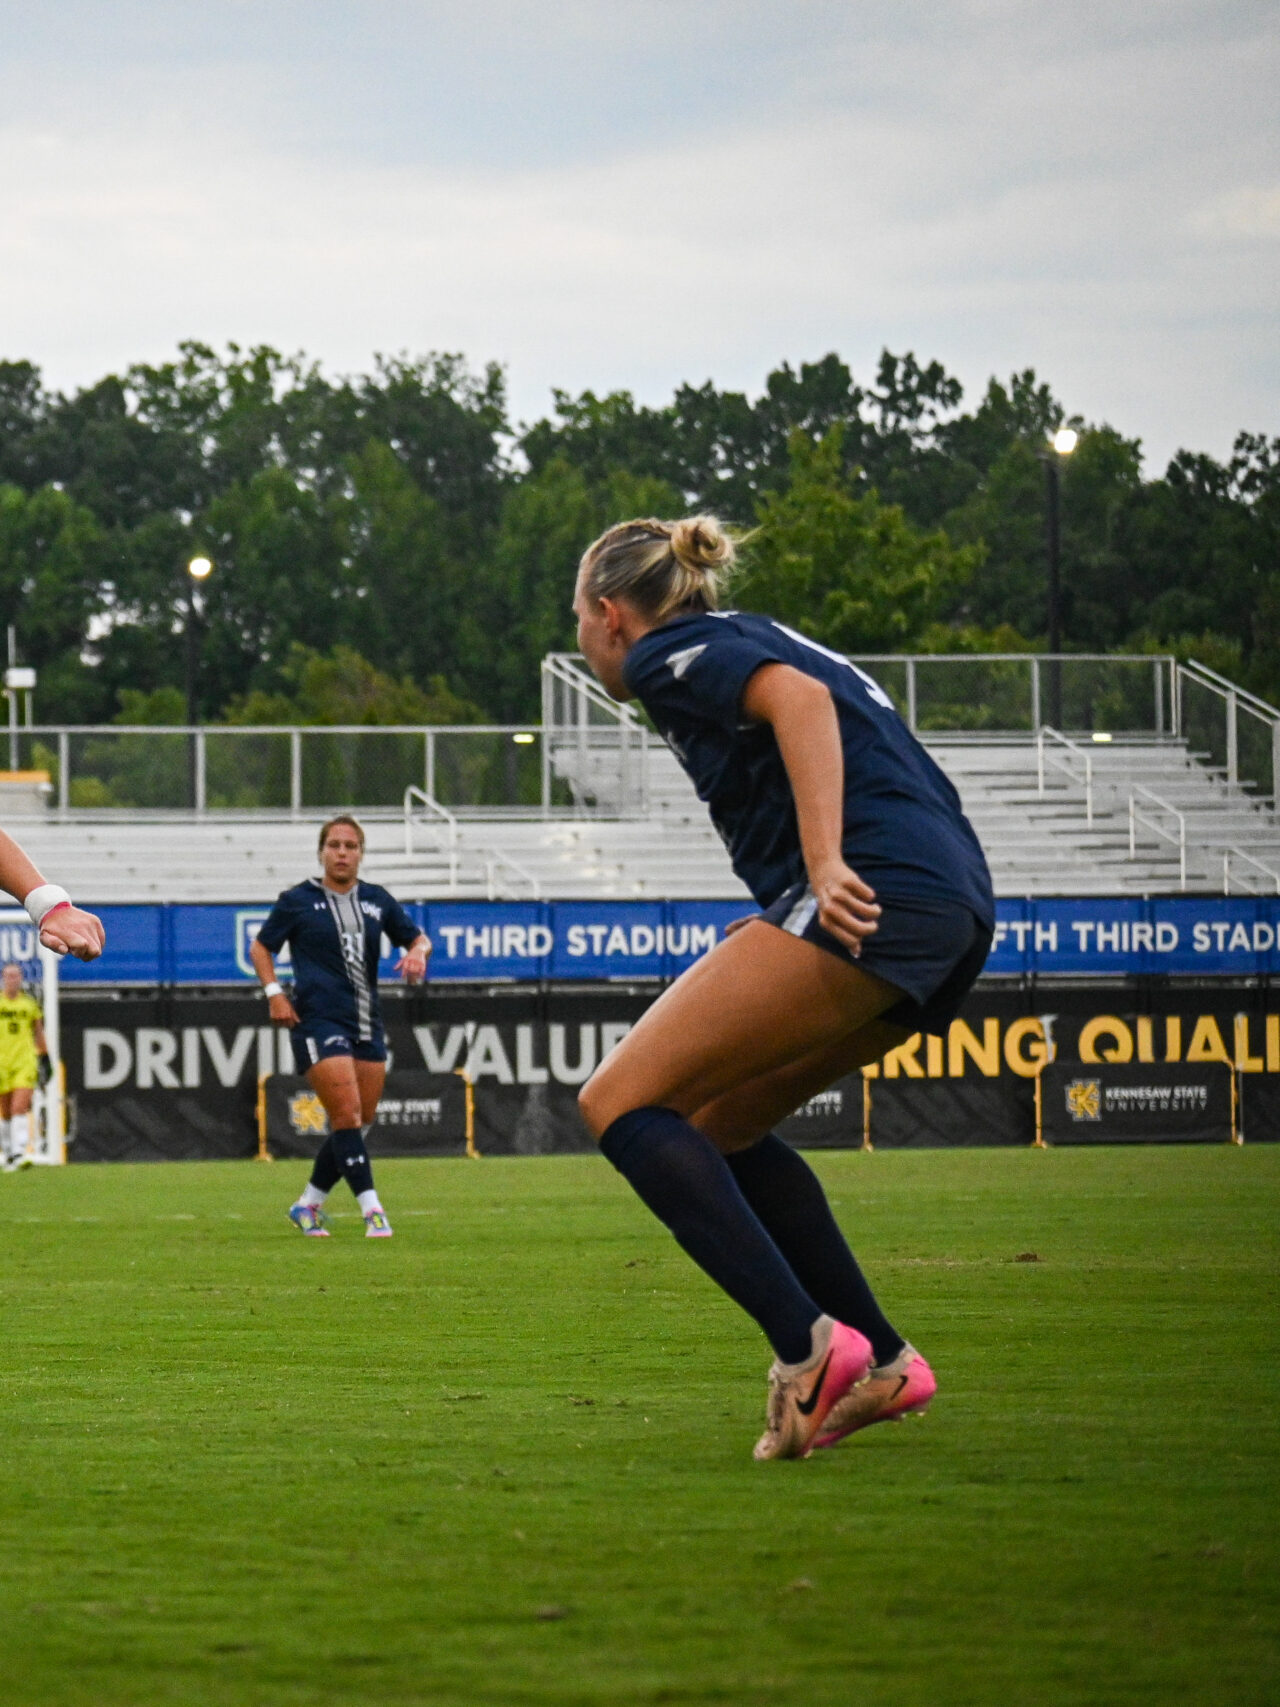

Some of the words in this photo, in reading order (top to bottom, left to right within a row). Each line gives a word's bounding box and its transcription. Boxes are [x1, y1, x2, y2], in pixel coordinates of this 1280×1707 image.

[440, 926, 552, 958] THIRD
[567, 924, 717, 957] STADIUM
[991, 921, 1058, 953] FTH
[1072, 921, 1179, 953] THIRD
[1105, 1086, 1171, 1100] KENNESAW
[1173, 1085, 1208, 1099] STATE
[1105, 1101, 1208, 1112] UNIVERSITY
